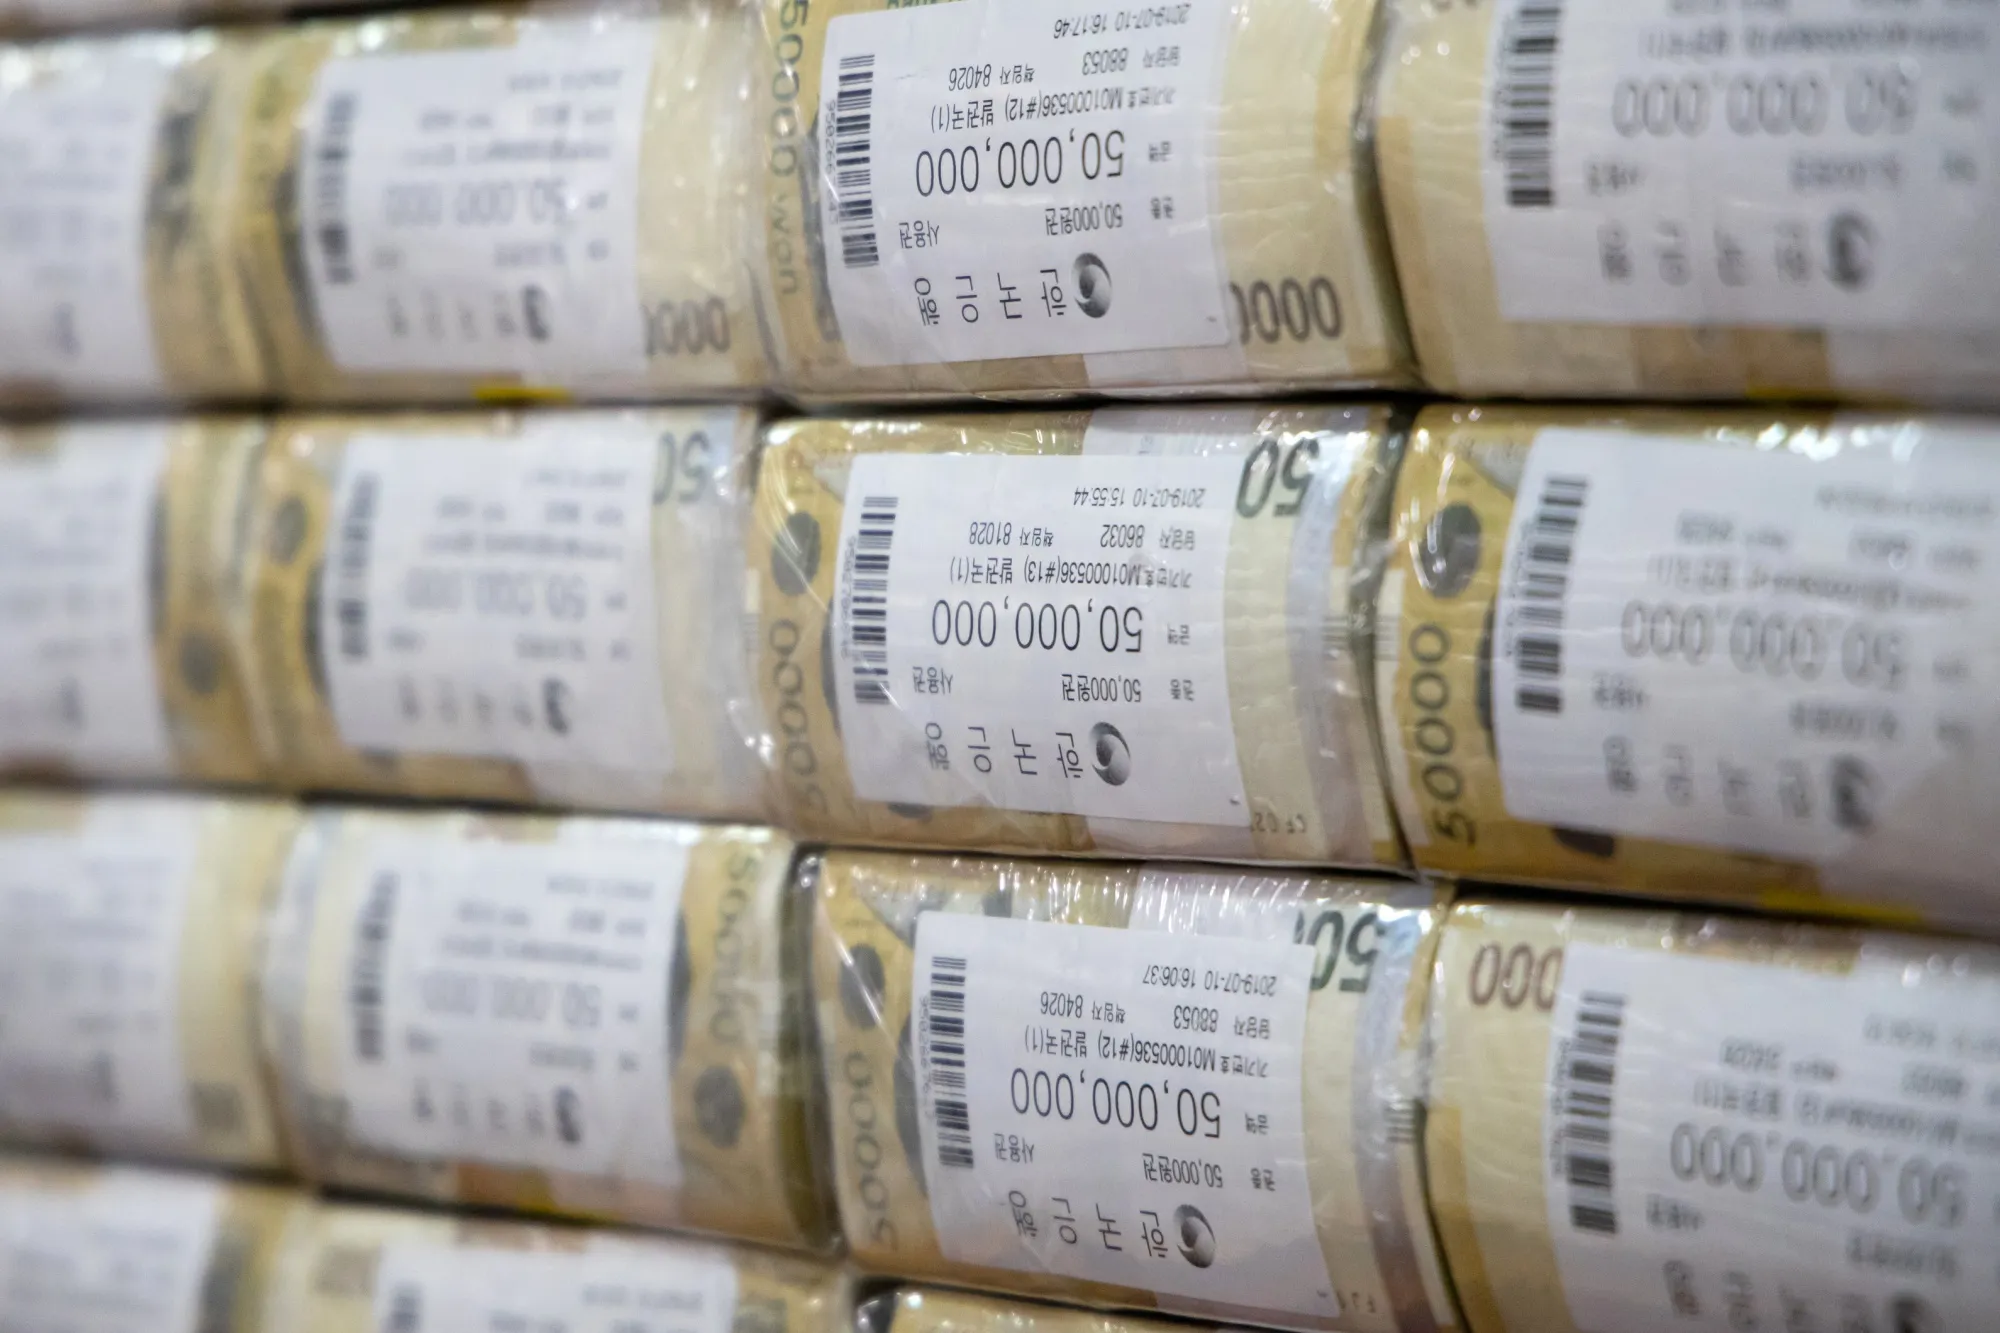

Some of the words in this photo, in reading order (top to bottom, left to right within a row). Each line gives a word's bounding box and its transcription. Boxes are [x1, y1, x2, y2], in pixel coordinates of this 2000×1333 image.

[1054, 14, 1108, 40] 16:17:46
[948, 64, 992, 91] 84026
[1000, 65, 1035, 82] 책임자
[931, 100, 994, 133] 발권국(1)
[1005, 86, 1122, 122] M01000536(#12)
[915, 129, 1125, 197] 50,000,000
[1044, 202, 1122, 236] 50,000원권
[899, 220, 939, 250] 사용권
[1074, 487, 1126, 507] 15:55:44
[1133, 487, 1205, 508] 2019-07-10
[969, 522, 1012, 544] 81028
[1020, 527, 1054, 546] 책임자
[1099, 524, 1145, 548] 86032
[950, 556, 1012, 584] 발권국(1)
[1023, 555, 1141, 583] M01000536(#13)
[931, 597, 1143, 653] 50,000,000
[912, 666, 953, 695] 사용권
[1061, 673, 1141, 702] 50,000원권
[1409, 624, 1478, 847] 50000
[1142, 965, 1196, 988] 16:06:37
[1204, 970, 1276, 997] 2019-07-10
[1040, 991, 1083, 1018] 84026
[1091, 1002, 1126, 1024] 책임자
[1173, 1004, 1219, 1032] 88053
[1024, 1025, 1087, 1057] 발권국(1)
[1234, 1016, 1270, 1038] 담당자
[1097, 1032, 1216, 1073] M01000536(#12)
[1220, 1055, 1268, 1077] 기기번호
[1010, 1067, 1221, 1138] 50,000,000
[994, 1133, 1034, 1163] 사용권
[1142, 1153, 1223, 1188] 50,000원권
[1251, 1169, 1276, 1191] 권종
